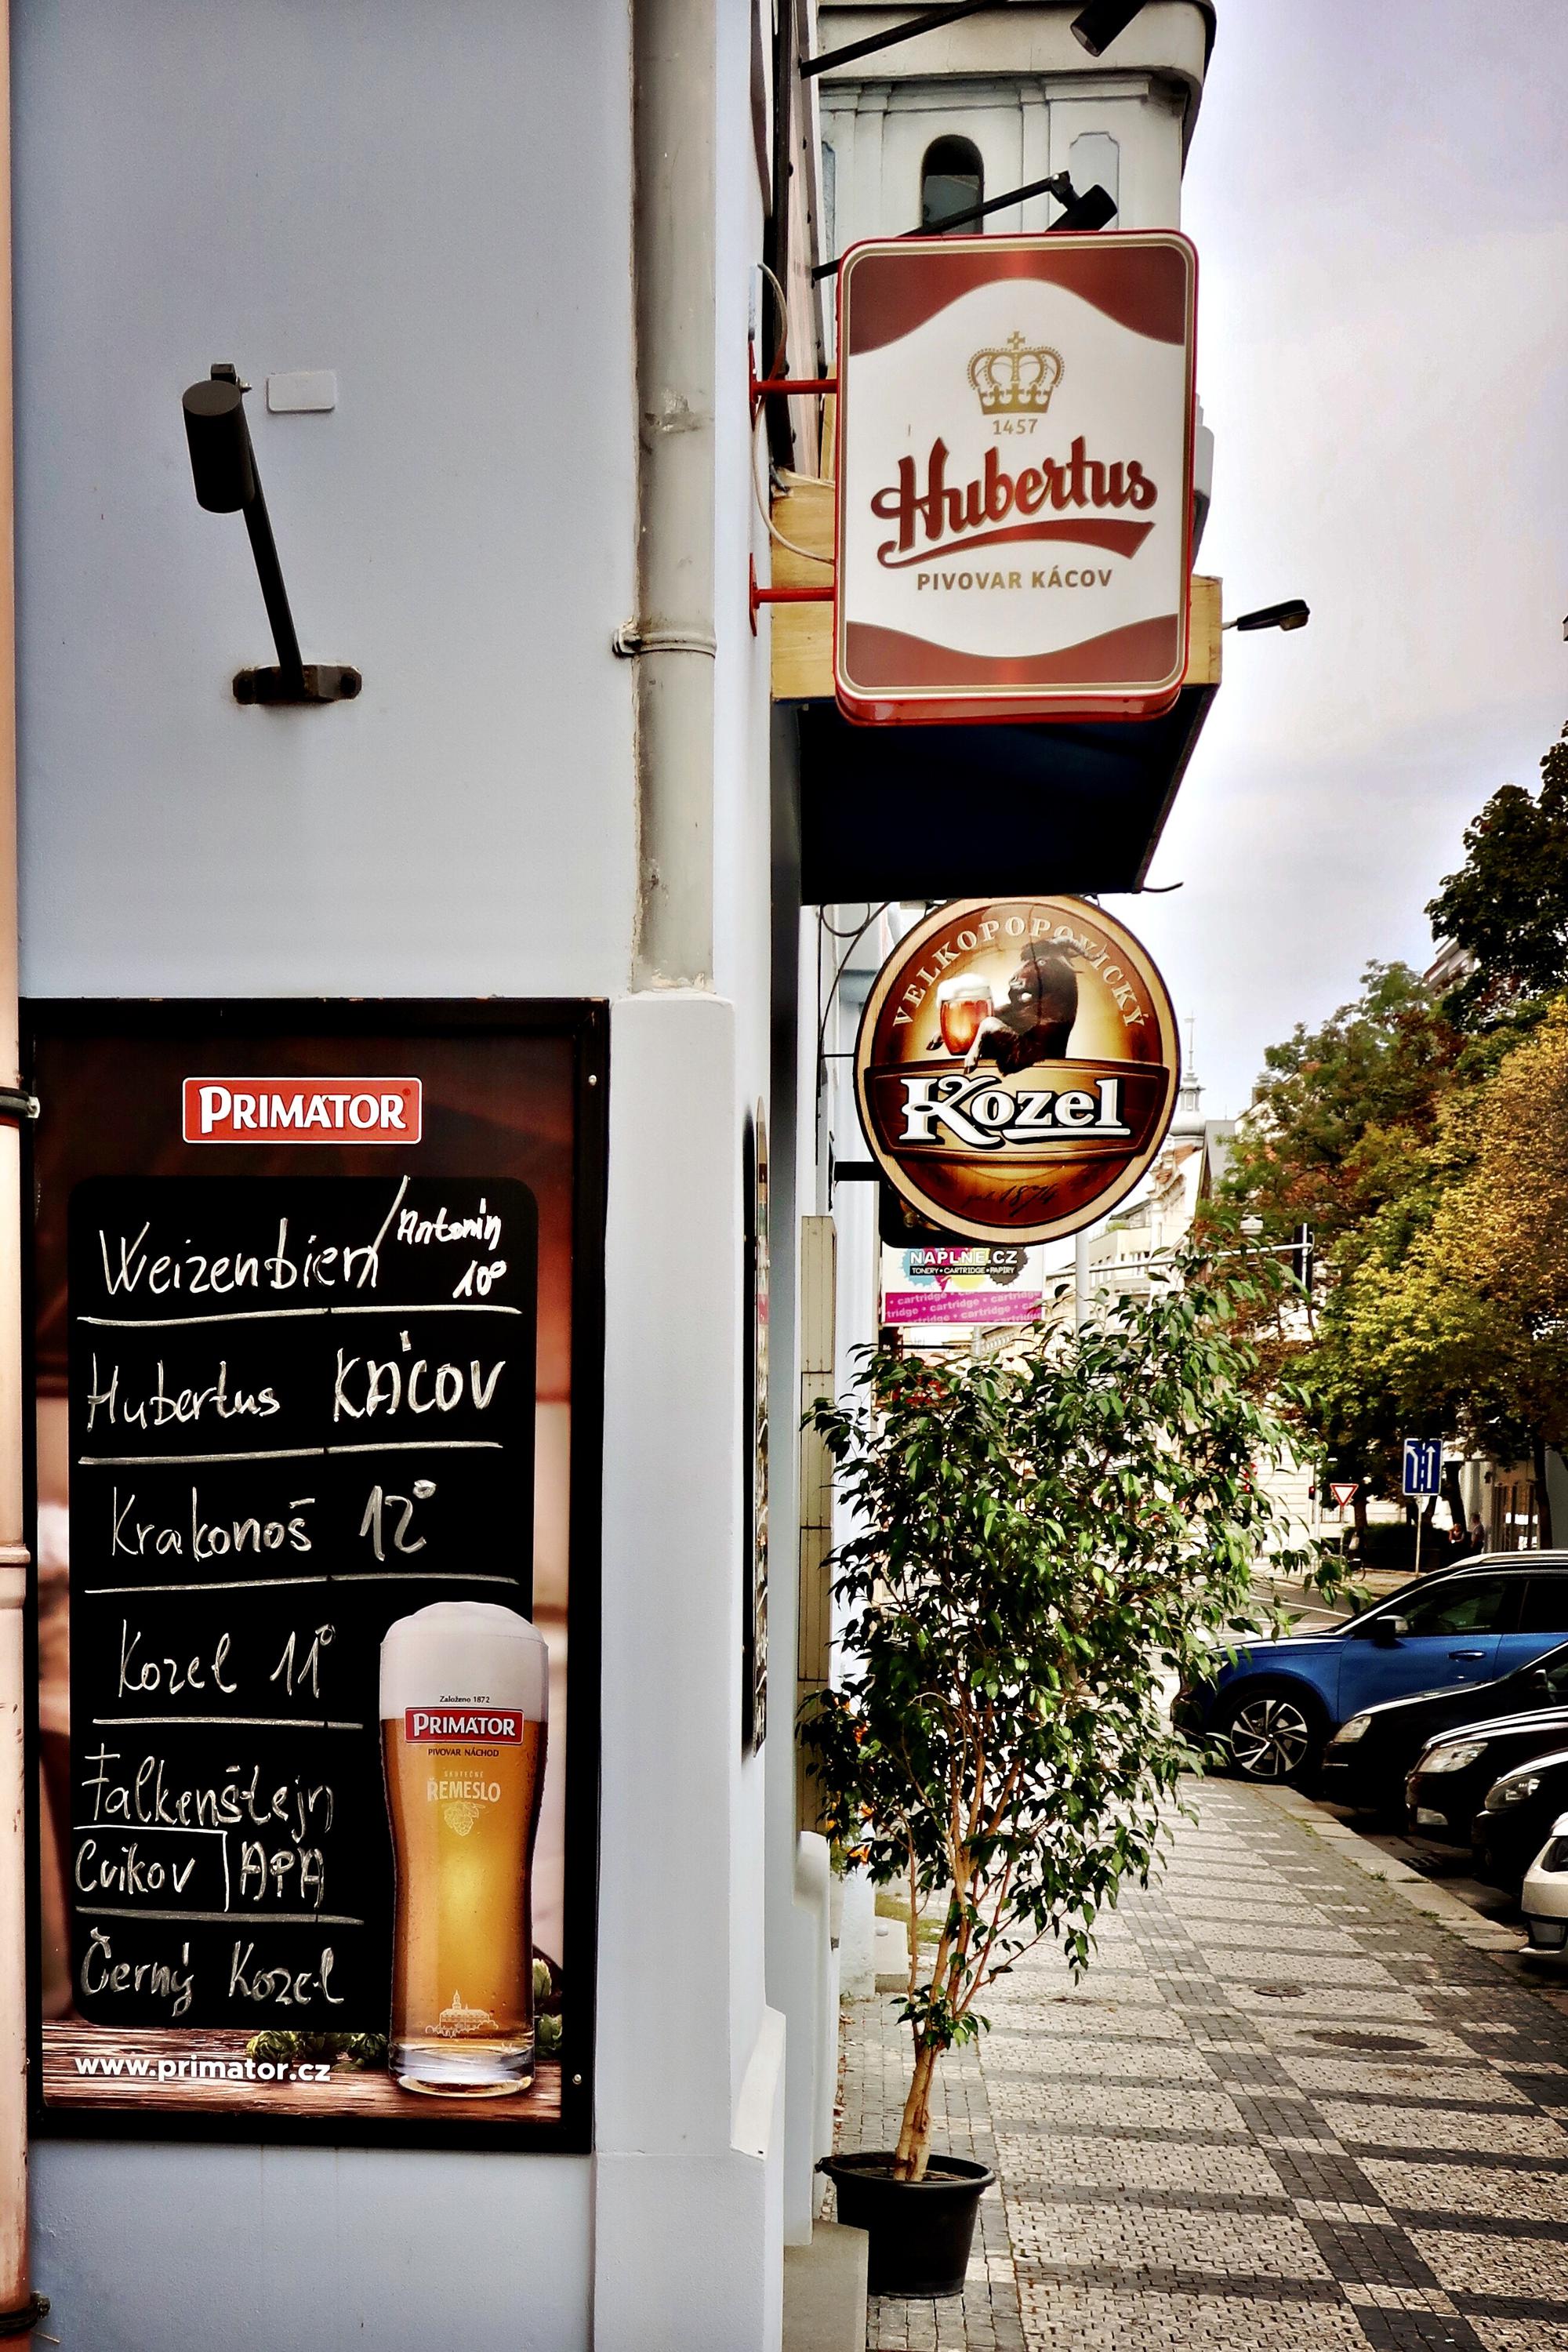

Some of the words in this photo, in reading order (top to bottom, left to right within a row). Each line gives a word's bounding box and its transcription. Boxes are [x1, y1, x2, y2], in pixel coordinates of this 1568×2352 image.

[993, 418, 1039, 436] 1457
[870, 435, 1158, 554] Hubertus
[916, 571, 1022, 591] PIVOVAR
[1032, 564, 1113, 590] KÁCOV
[899, 1074, 1131, 1147] Kozel
[897, 1292, 948, 1305] cartridge
[930, 1298, 980, 1312] cartridge
[960, 1305, 1011, 1319] cartridge
[86, 1352, 281, 1432] Hubertus
[118, 1619, 238, 1698] Kozel
[439, 1695, 471, 1704] Založeno
[427, 1748, 462, 1757] PIVOVAR
[464, 1746, 499, 1758] NÁCHOD
[426, 1777, 502, 1803] ŘEMESLO
[74, 1838, 196, 1896] Cvikov
[240, 1841, 325, 1908] APA
[80, 1926, 194, 2017] Černý
[228, 1940, 345, 2005] Kozel
[74, 2054, 332, 2082] www.primator.cz
